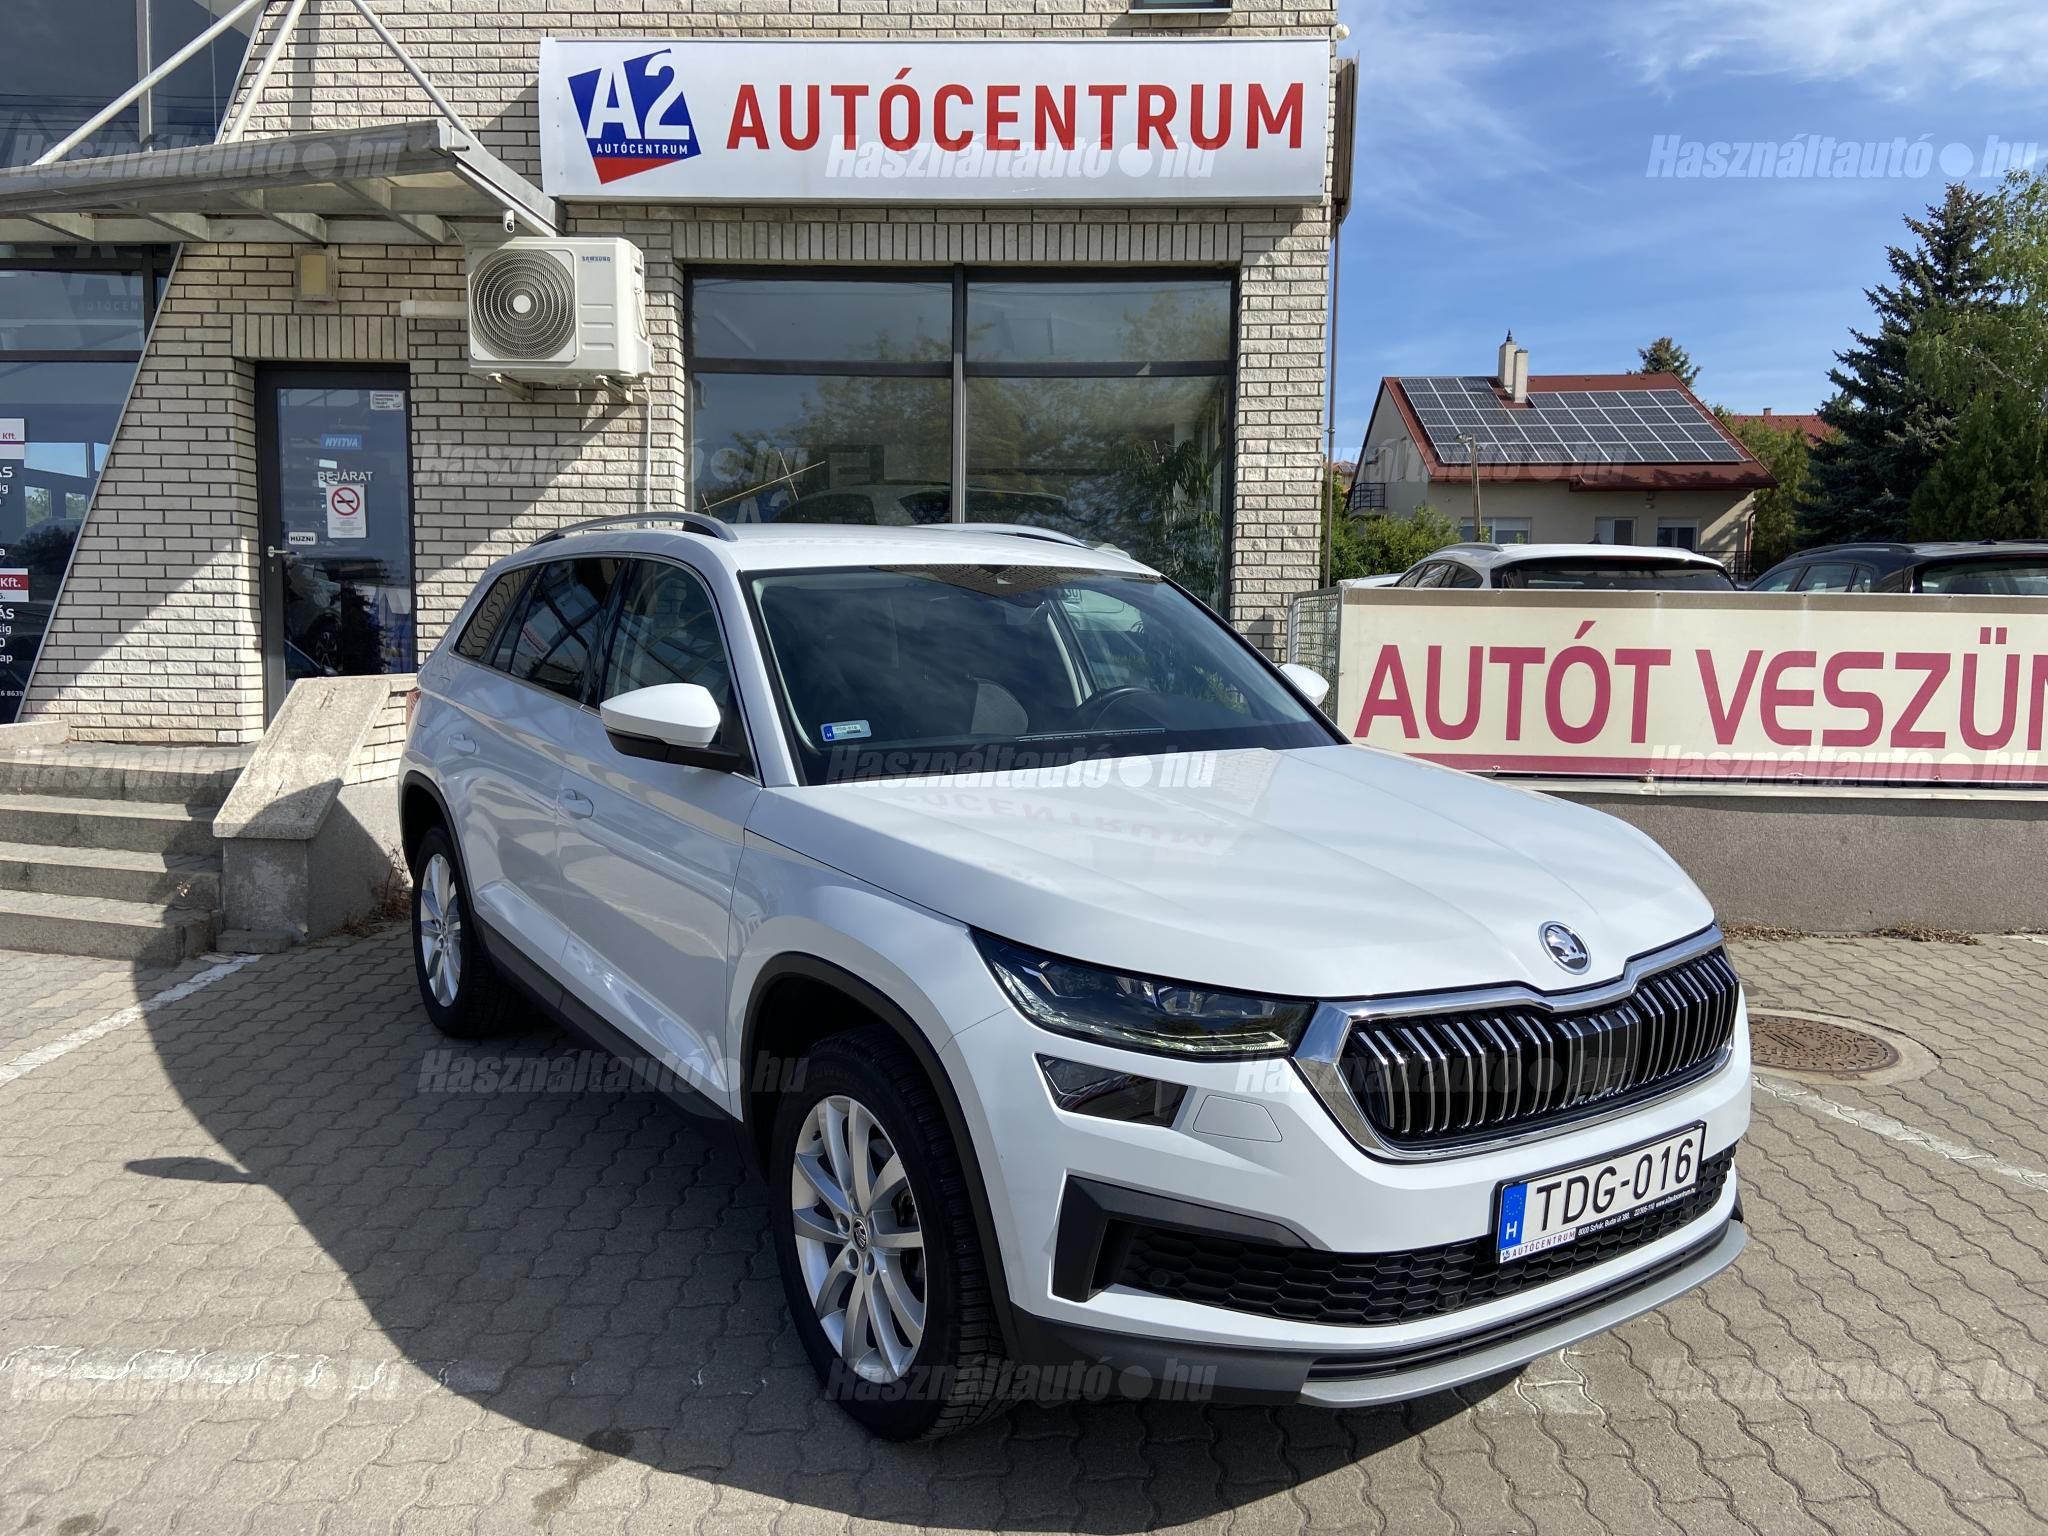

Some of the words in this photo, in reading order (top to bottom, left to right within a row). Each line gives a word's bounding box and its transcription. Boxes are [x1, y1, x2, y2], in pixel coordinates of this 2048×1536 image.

[587, 50, 689, 139] A2
[728, 68, 1303, 151] AUTÓCENTRUM
[595, 143, 689, 156] AUTÓCENTRUM
[325, 437, 358, 448] NYITVA
[317, 469, 373, 481] BEJÁRAT
[1355, 621, 1671, 744] AUTÓT
[1537, 1139, 1694, 1231] TDG-016
[1505, 1221, 1518, 1241] H
